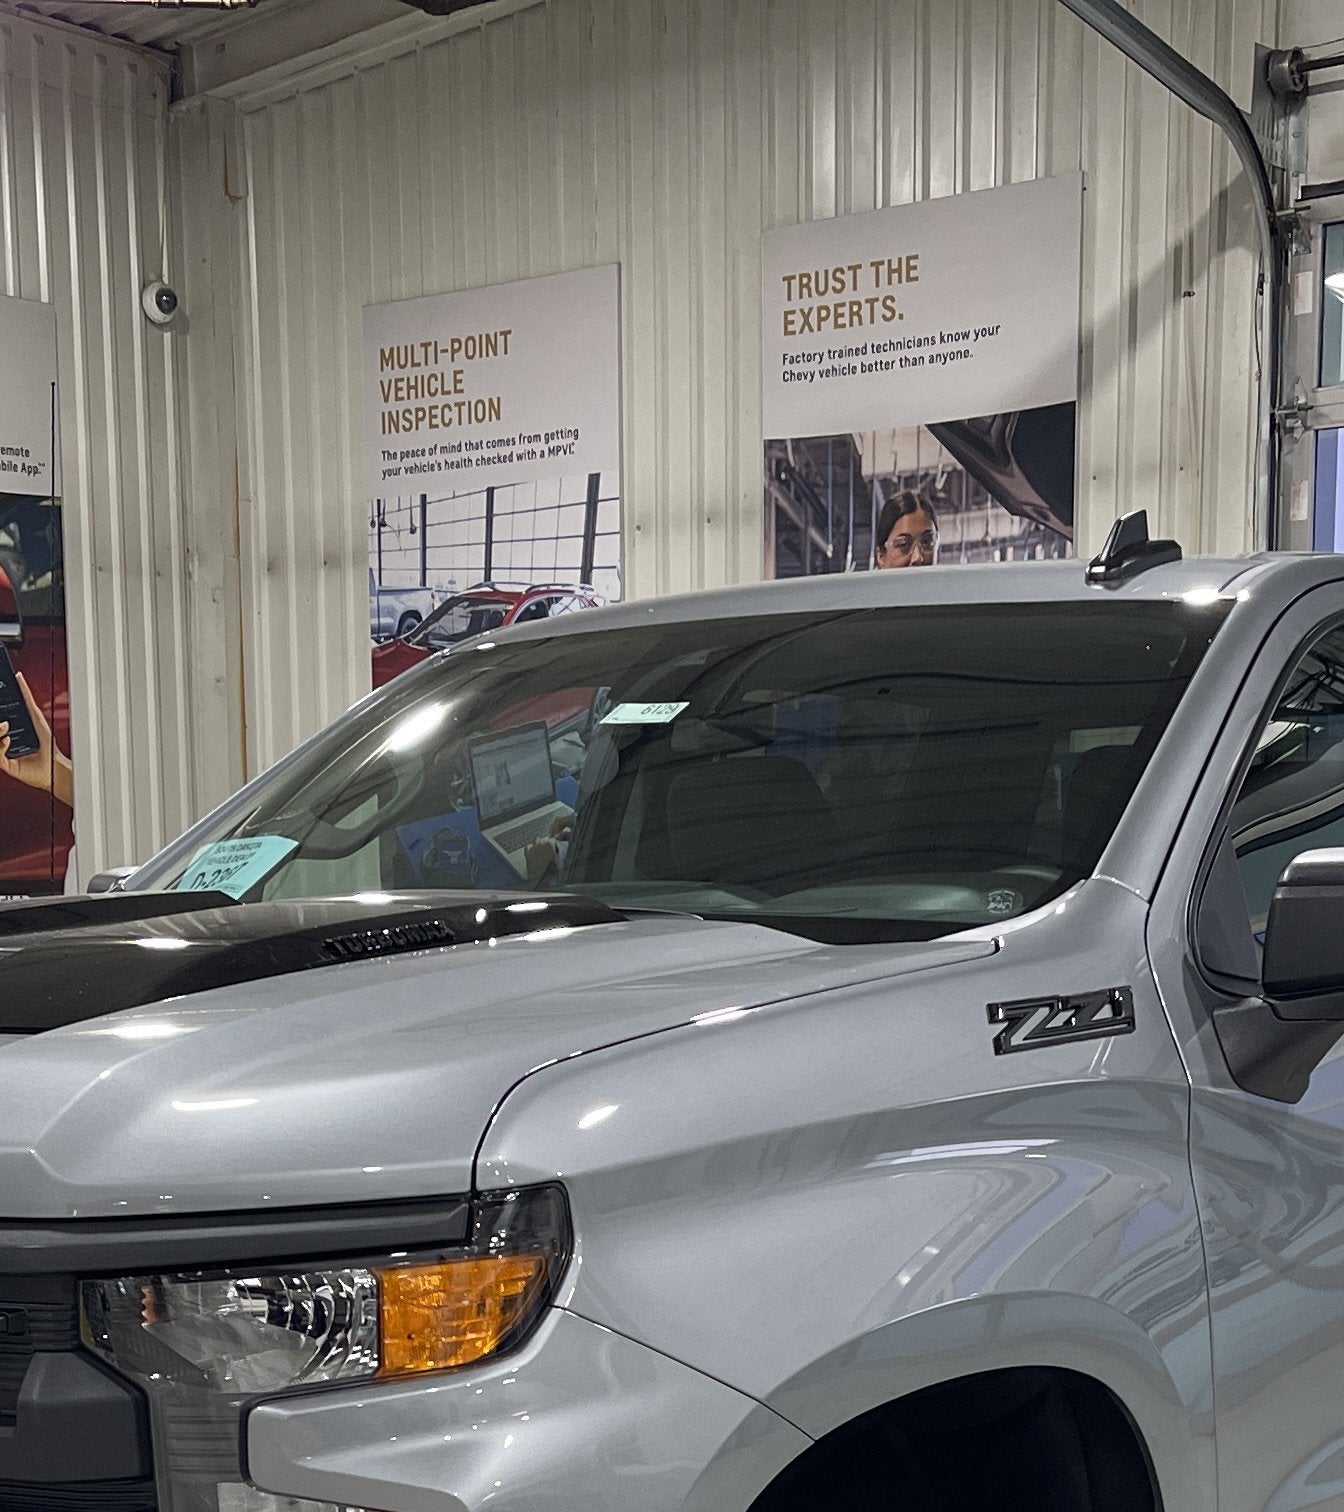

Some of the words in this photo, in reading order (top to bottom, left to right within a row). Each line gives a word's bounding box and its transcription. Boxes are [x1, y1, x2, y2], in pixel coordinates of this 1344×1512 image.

[782, 263, 862, 302] TRUST
[870, 254, 919, 288] THE
[783, 295, 904, 337] EXPERTS.
[380, 330, 512, 373] MULTI-POINT
[782, 350, 825, 366] Factory
[827, 343, 867, 361] trained
[870, 335, 936, 355] technicians
[939, 329, 970, 345] know
[973, 324, 1001, 342] your
[782, 369, 816, 384] Chevy
[819, 363, 857, 379] vehicle
[860, 358, 896, 374] better
[899, 353, 925, 369] than
[928, 348, 974, 367] anyone.
[380, 370, 465, 403] VEHICLE
[382, 397, 502, 435] INSPECTION
[382, 450, 397, 462] The
[400, 447, 426, 462] peace
[428, 443, 438, 456] of
[440, 440, 462, 455] mind
[465, 438, 484, 452] that
[486, 435, 516, 448] comes
[518, 432, 541, 445] from
[544, 427, 579, 444] getting
[382, 467, 401, 480] your
[404, 460, 441, 475] vehicle's
[444, 455, 473, 471] health
[475, 450, 513, 467] checked
[516, 448, 537, 462] with
[539, 450, 546, 459] a
[986, 985, 1136, 1056] Z71
